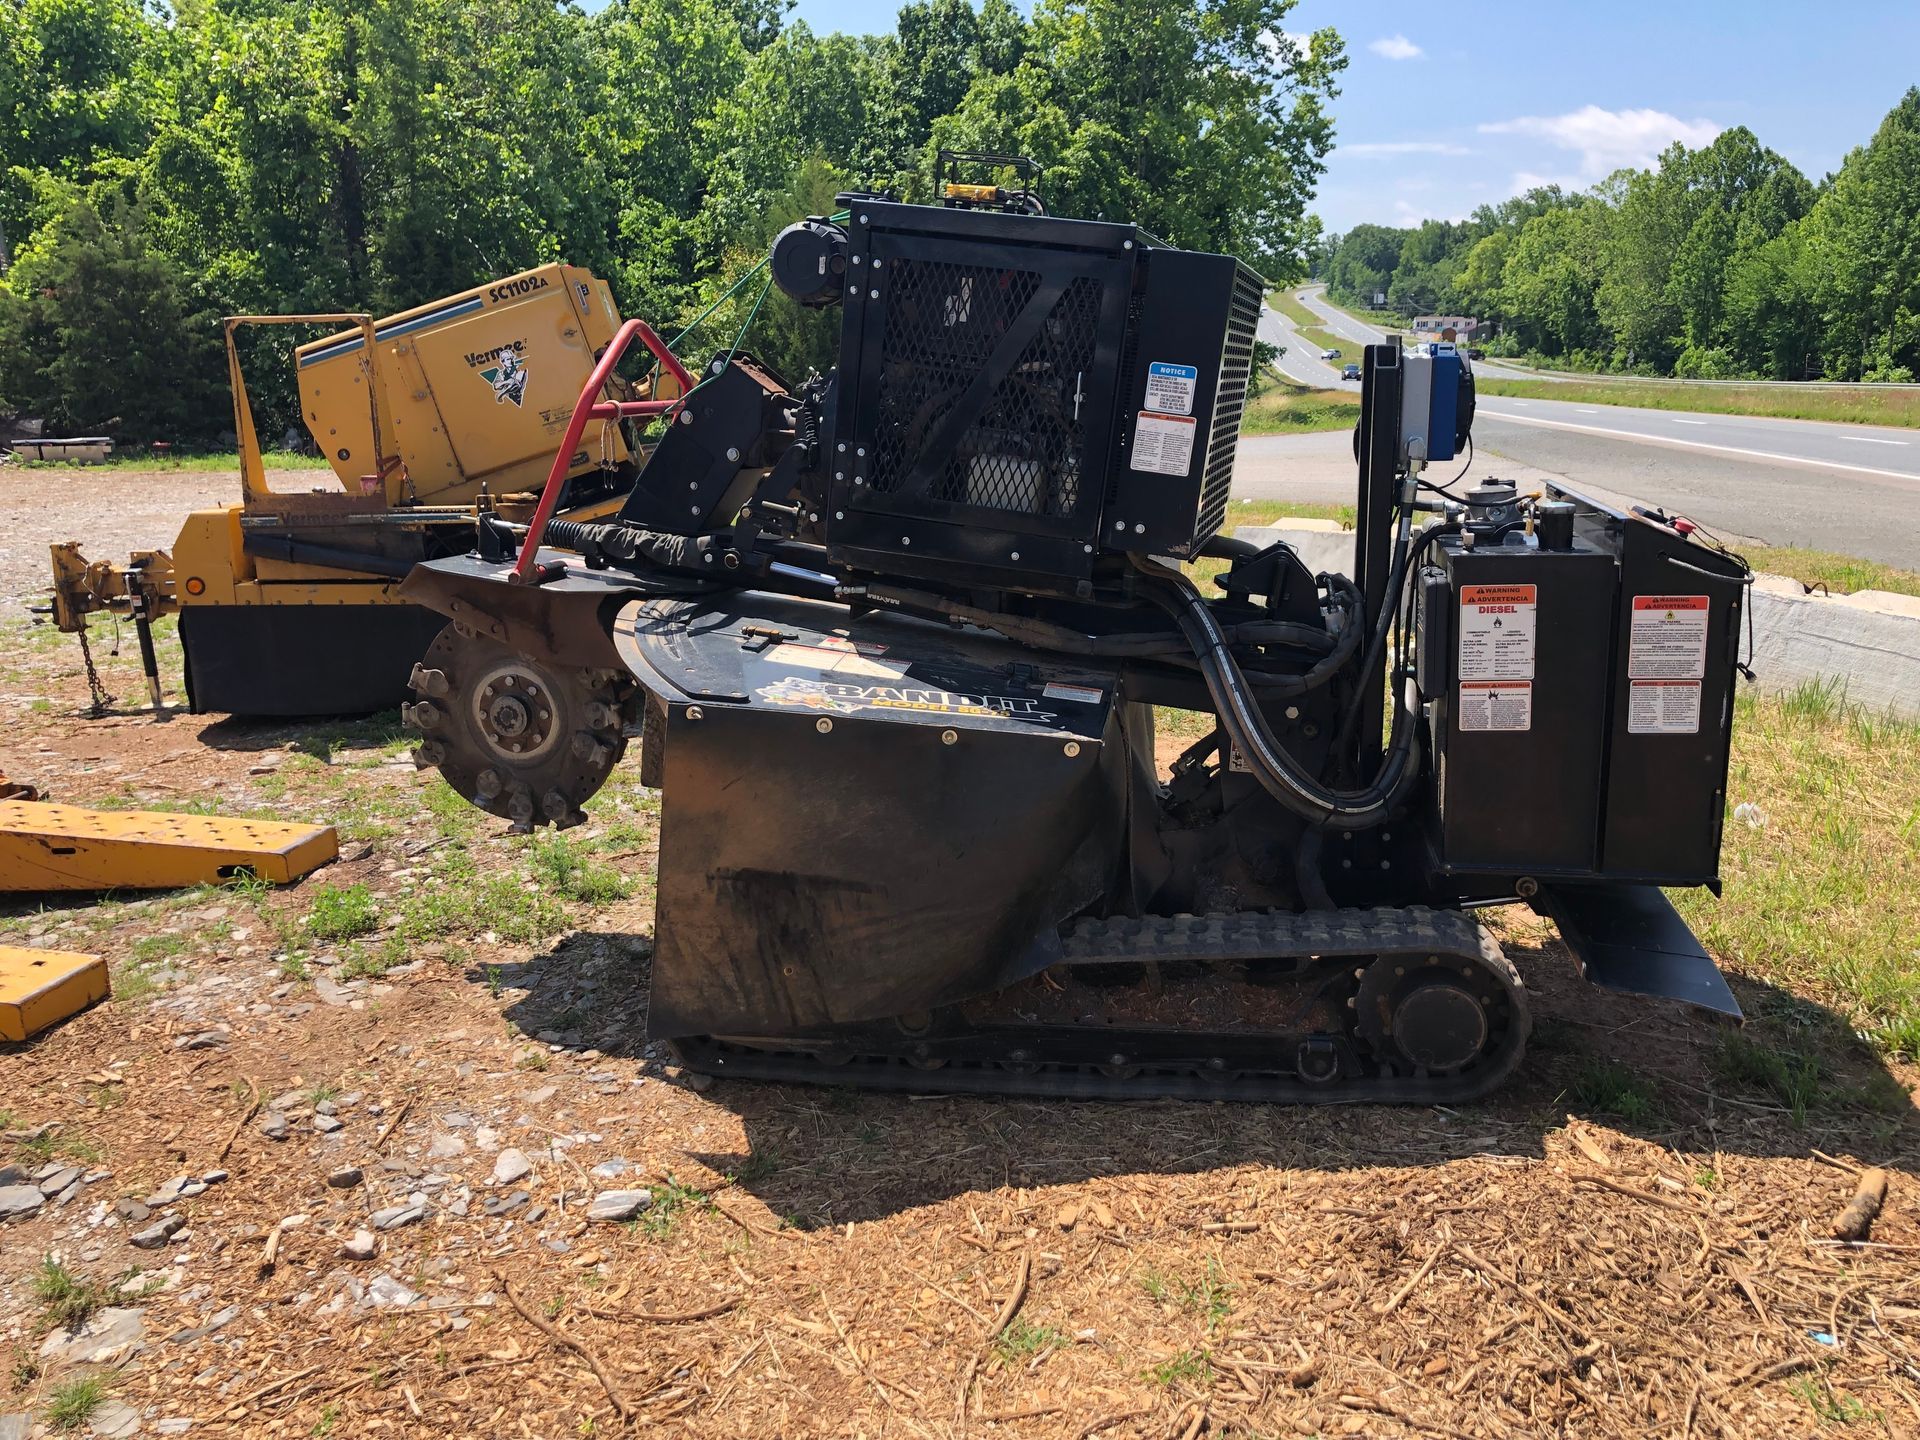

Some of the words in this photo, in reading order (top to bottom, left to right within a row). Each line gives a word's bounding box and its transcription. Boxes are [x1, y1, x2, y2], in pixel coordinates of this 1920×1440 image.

[489, 276, 549, 304] SC1102A
[1160, 367, 1186, 376] NOTICE
[1478, 605, 1518, 614] DIESEL
[824, 684, 1038, 713] BANDIT
[871, 699, 948, 713] MODEL
